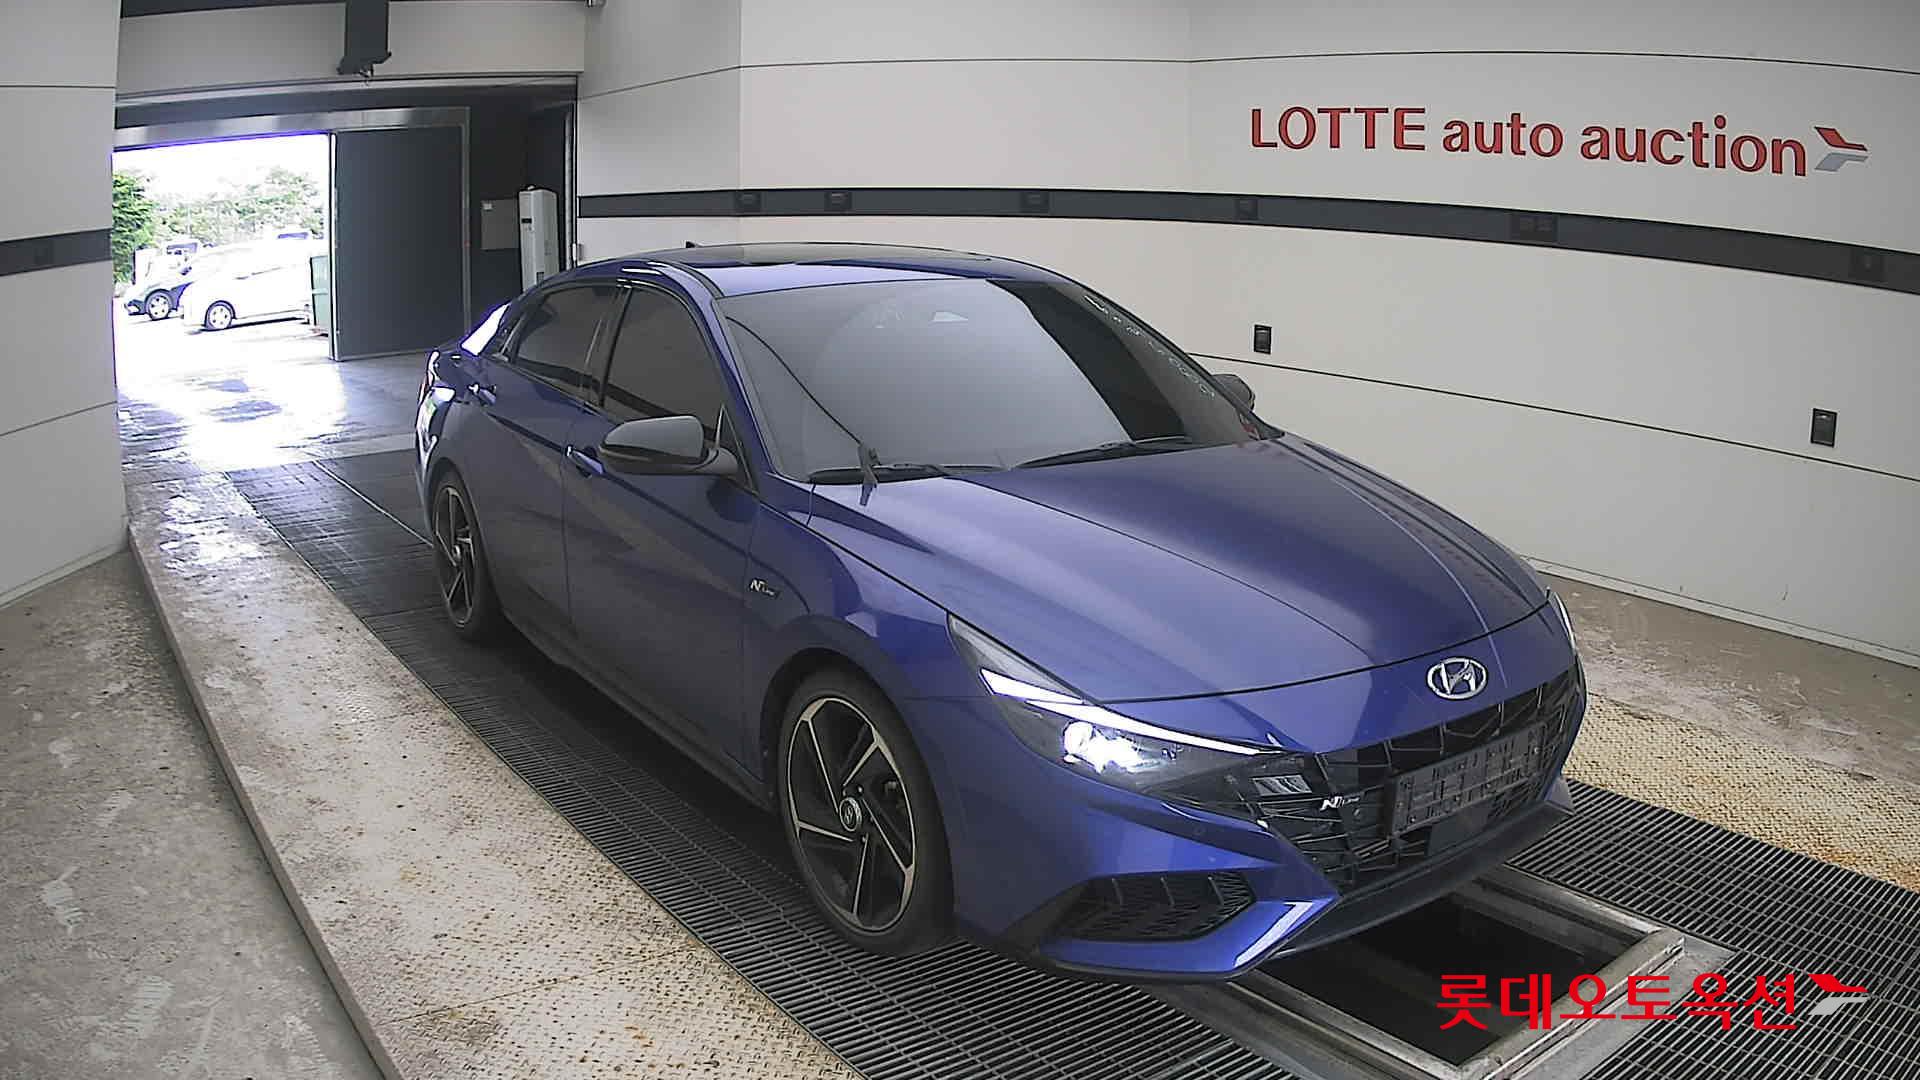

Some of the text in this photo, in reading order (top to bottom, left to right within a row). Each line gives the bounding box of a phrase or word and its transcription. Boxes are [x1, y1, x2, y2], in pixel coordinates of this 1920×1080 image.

[1250, 106, 1809, 176] LOTTE auto auction
